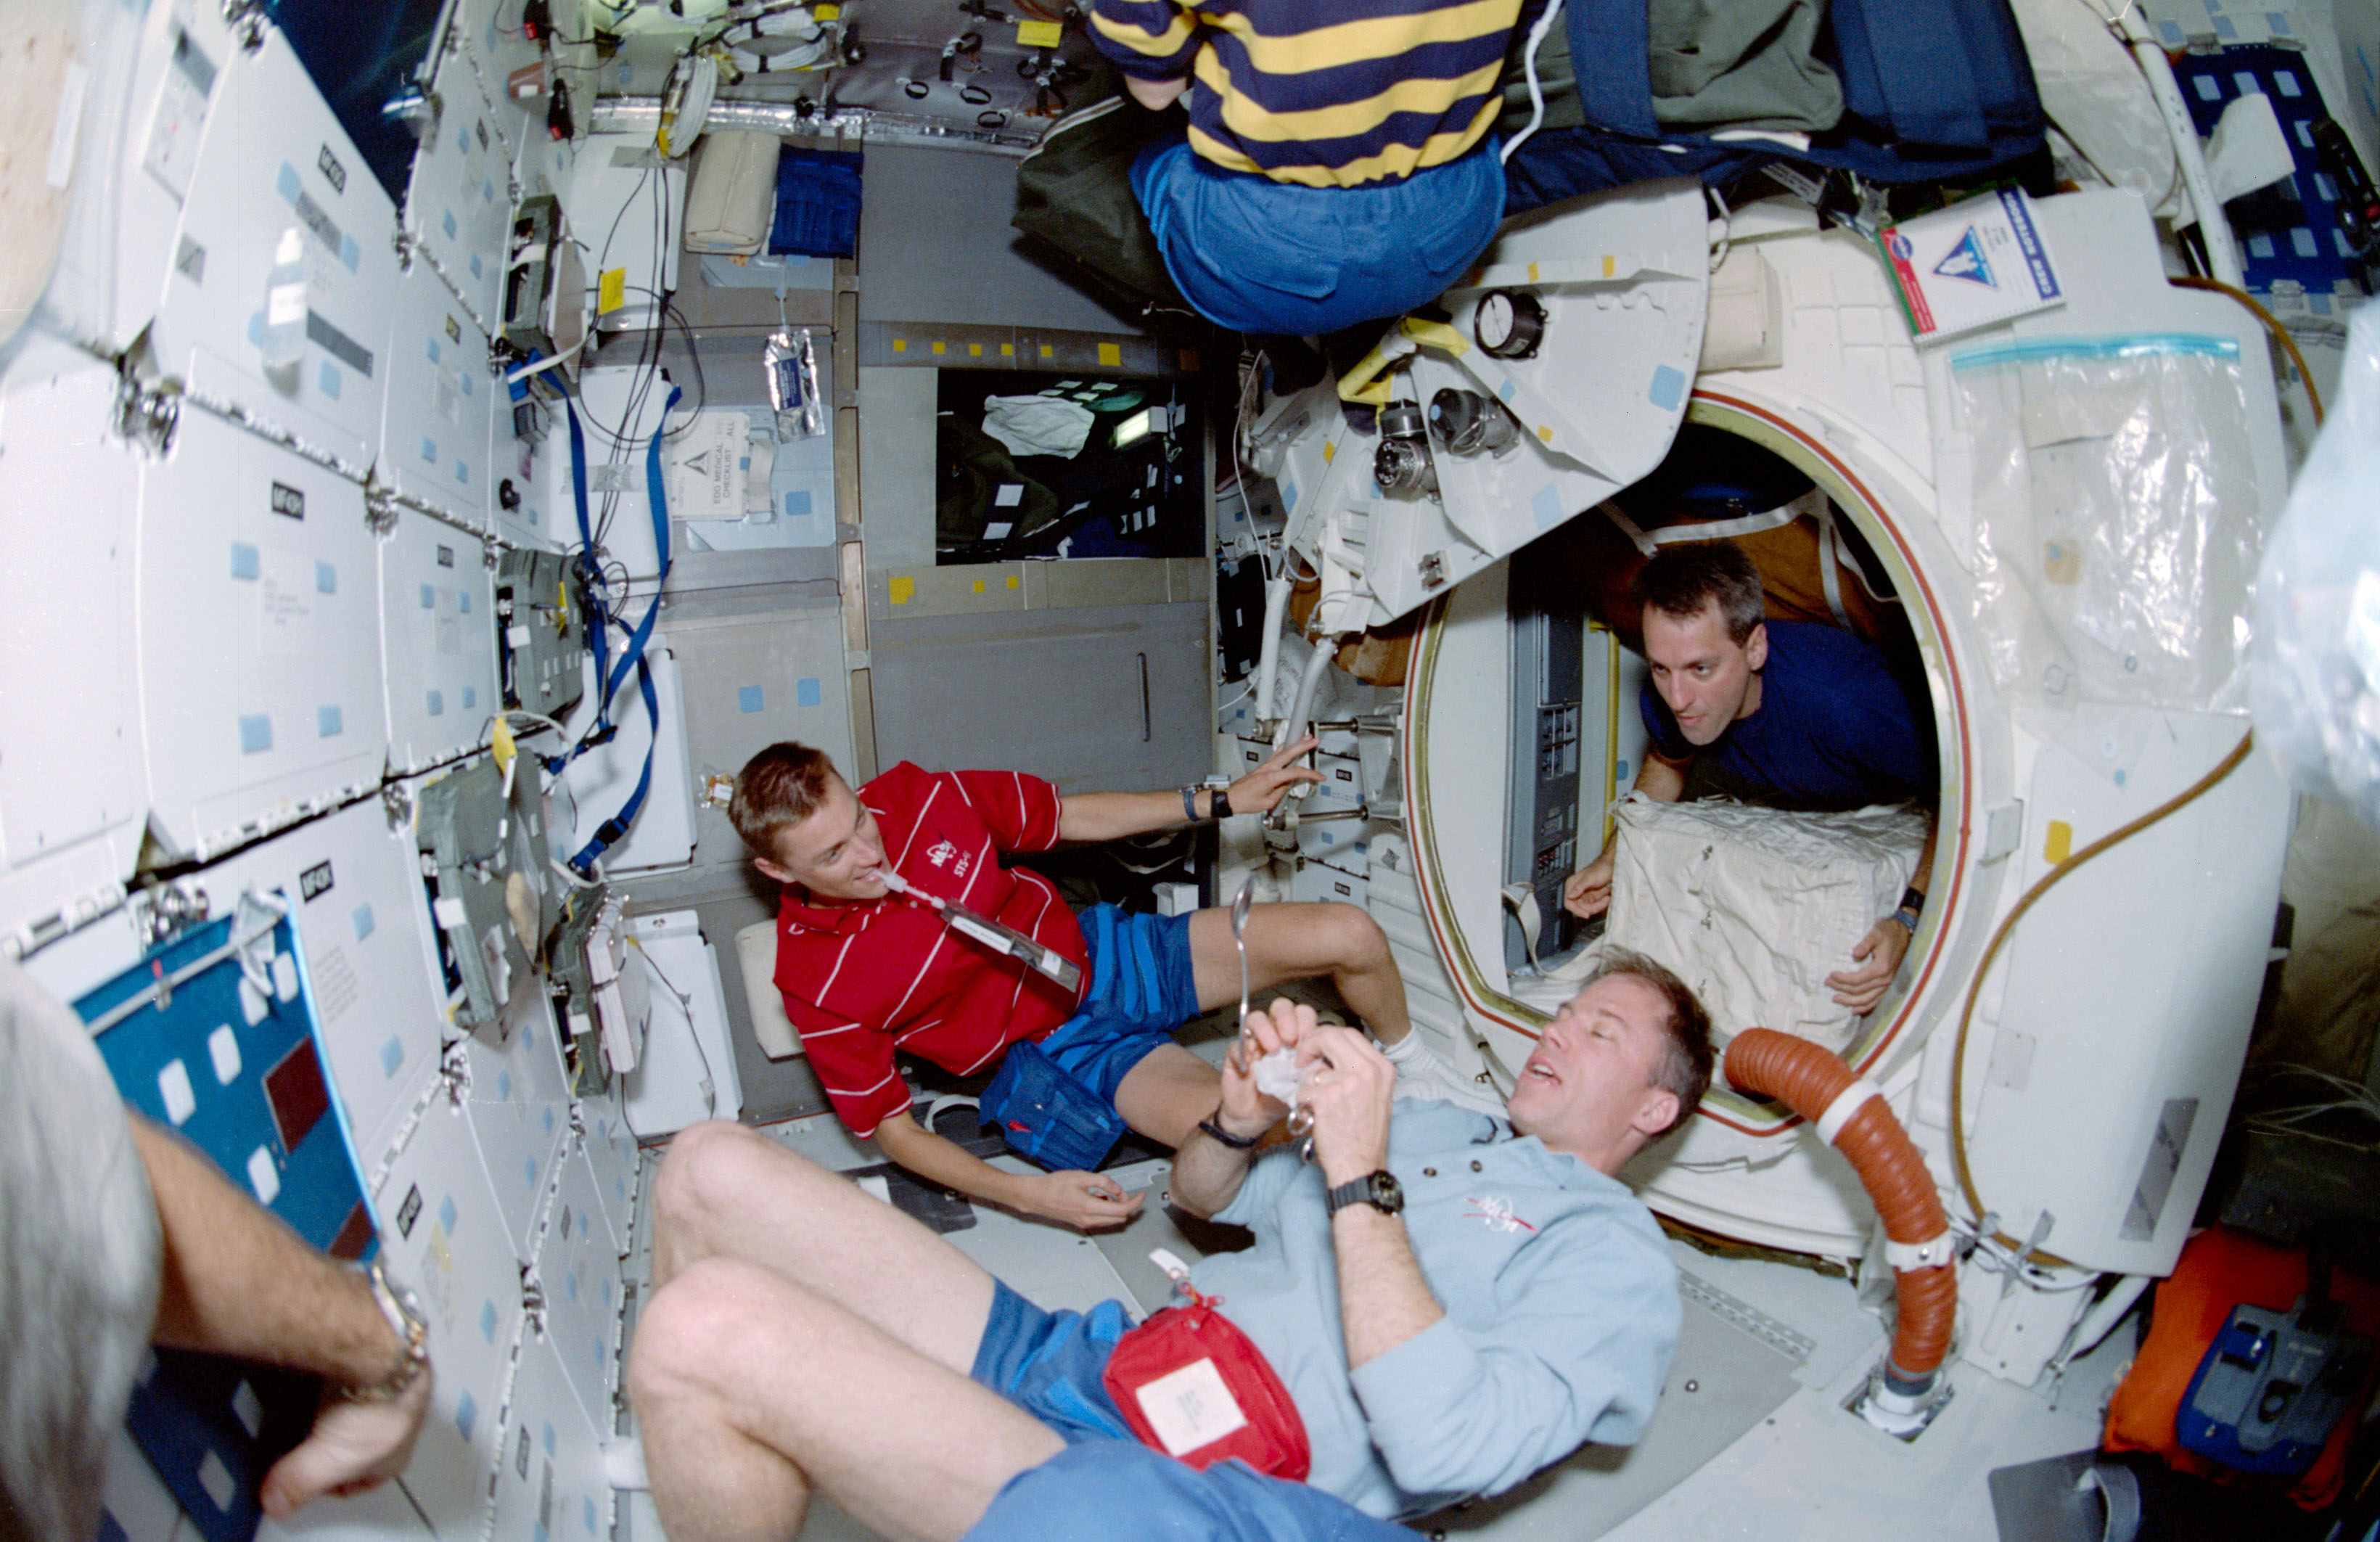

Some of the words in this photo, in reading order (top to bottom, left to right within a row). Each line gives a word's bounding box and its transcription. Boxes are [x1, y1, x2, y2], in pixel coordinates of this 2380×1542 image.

[2003, 191, 2037, 255] NOTEBOOK
[2031, 259, 2053, 296] CREW
[714, 443, 723, 483] MEDICAL
[723, 448, 732, 499] CHECKLIST
[713, 485, 721, 504] EDO
